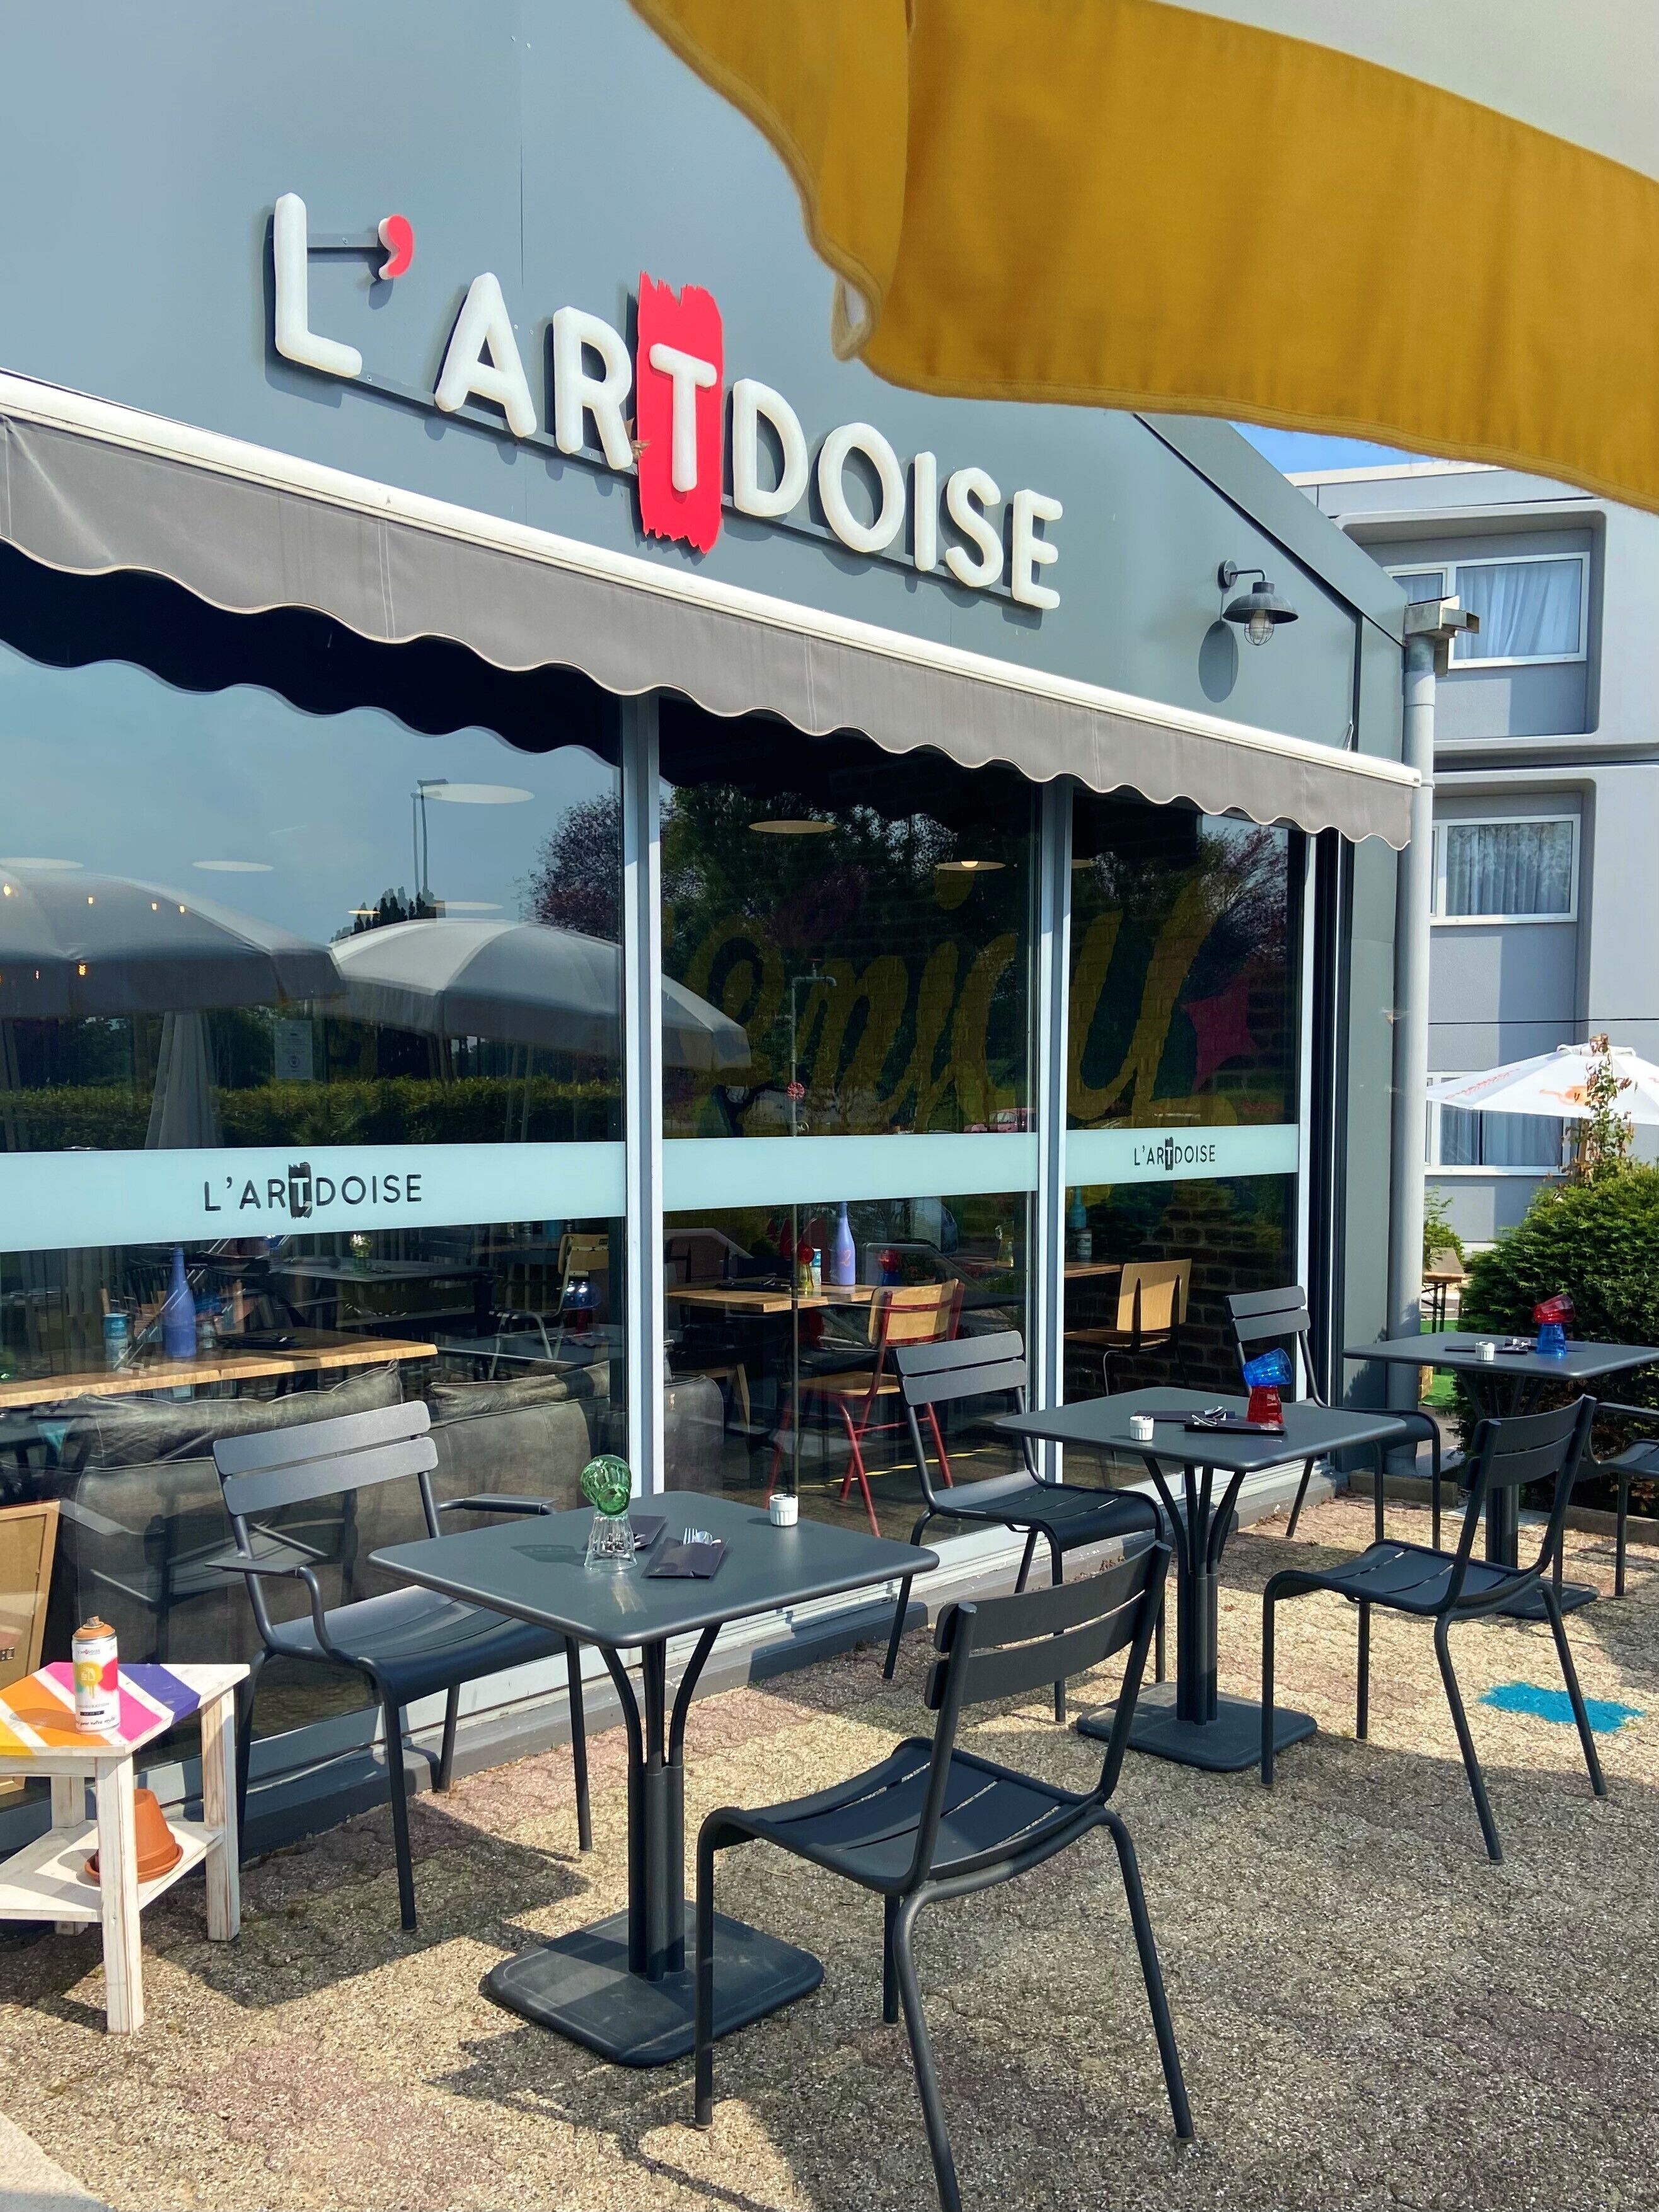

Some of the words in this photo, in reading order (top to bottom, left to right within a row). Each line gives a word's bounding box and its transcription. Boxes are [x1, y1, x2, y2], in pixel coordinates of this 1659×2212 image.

[274, 192, 1063, 610] L'ARTDOISE
[1134, 1137, 1216, 1171] L'ARTDOISE
[204, 1162, 422, 1219] L'ARTDOISE
